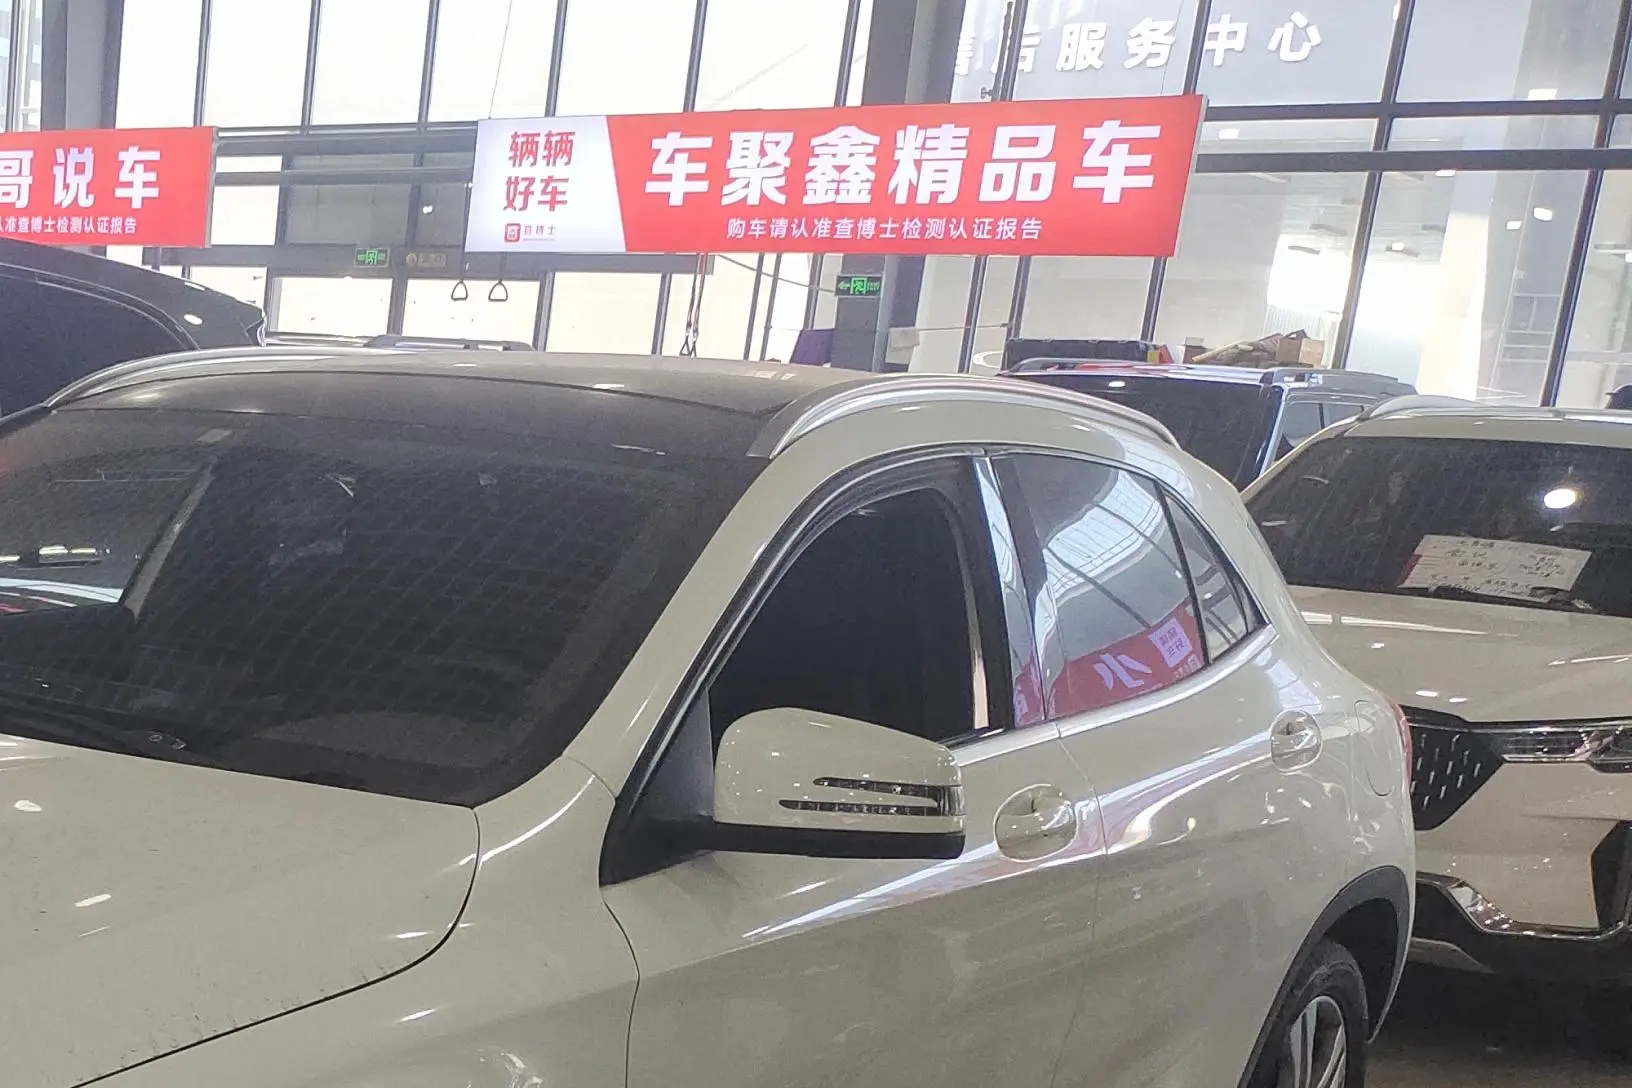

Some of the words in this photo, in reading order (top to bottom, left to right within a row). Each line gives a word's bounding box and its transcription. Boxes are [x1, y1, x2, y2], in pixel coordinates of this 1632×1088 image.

[508, 130, 576, 167] 辆辆
[645, 119, 1162, 206] 车聚鑫精品车
[503, 175, 569, 211] 好车
[725, 217, 1044, 241] 购车请认准查博士检测认证报告
